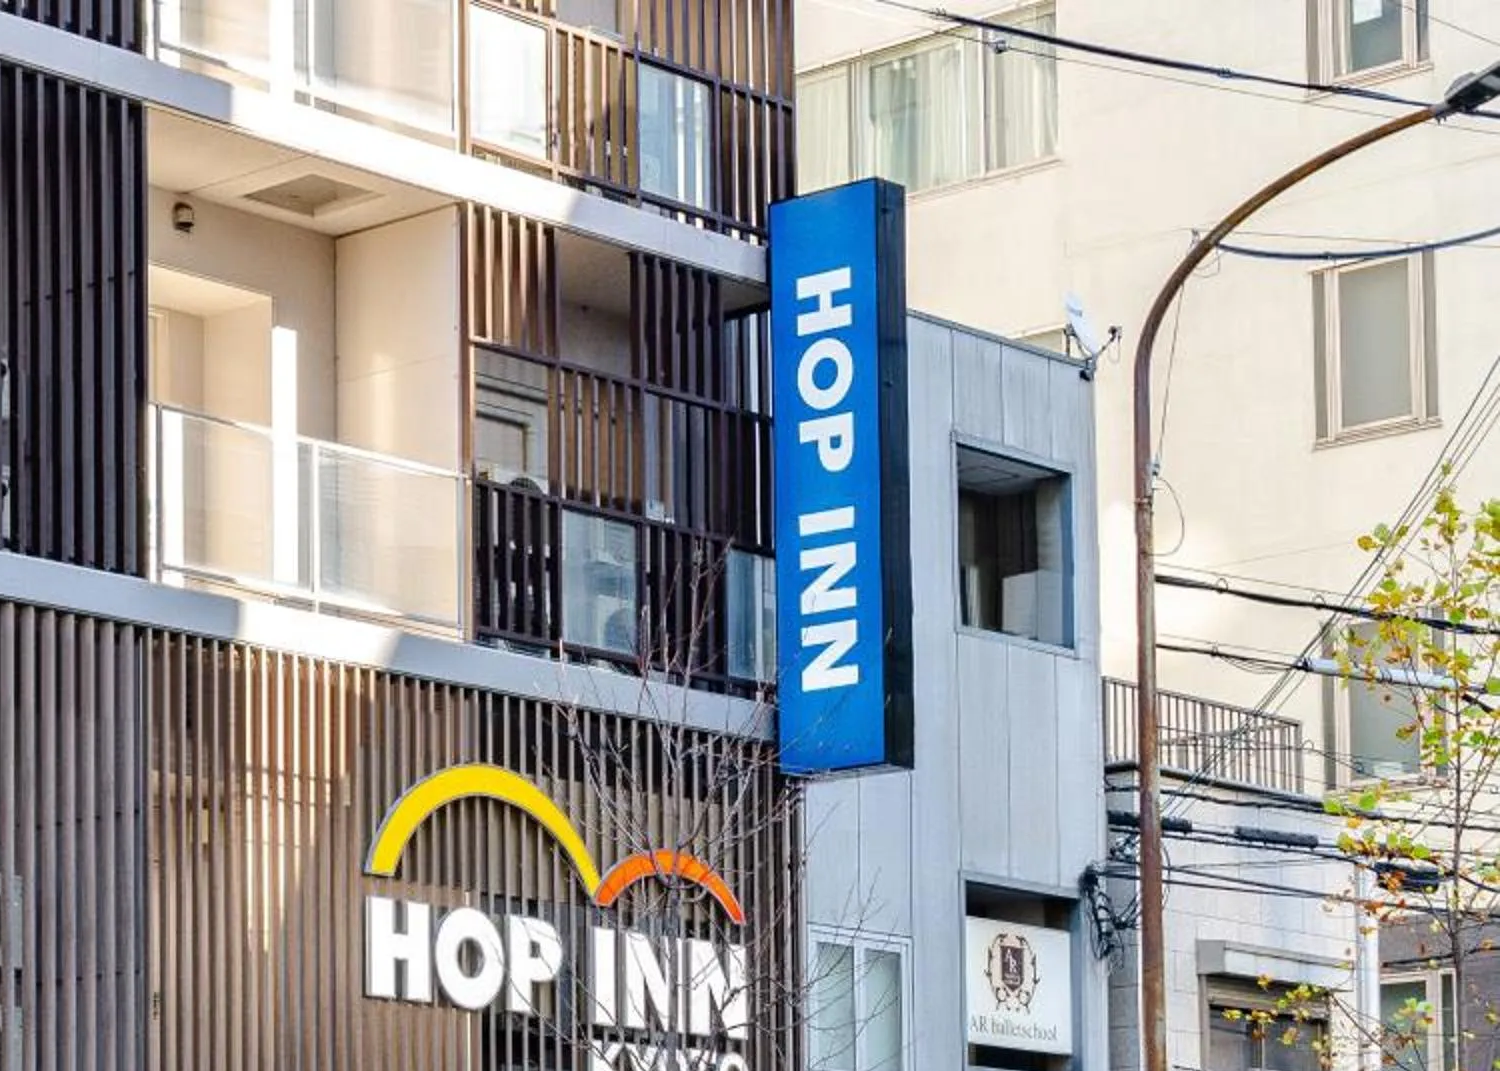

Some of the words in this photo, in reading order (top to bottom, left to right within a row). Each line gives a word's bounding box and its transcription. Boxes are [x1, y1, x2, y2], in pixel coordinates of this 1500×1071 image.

[796, 266, 854, 473] HOP
[798, 505, 859, 693] INN
[366, 895, 564, 1012] HOP
[589, 926, 750, 1041] INN
